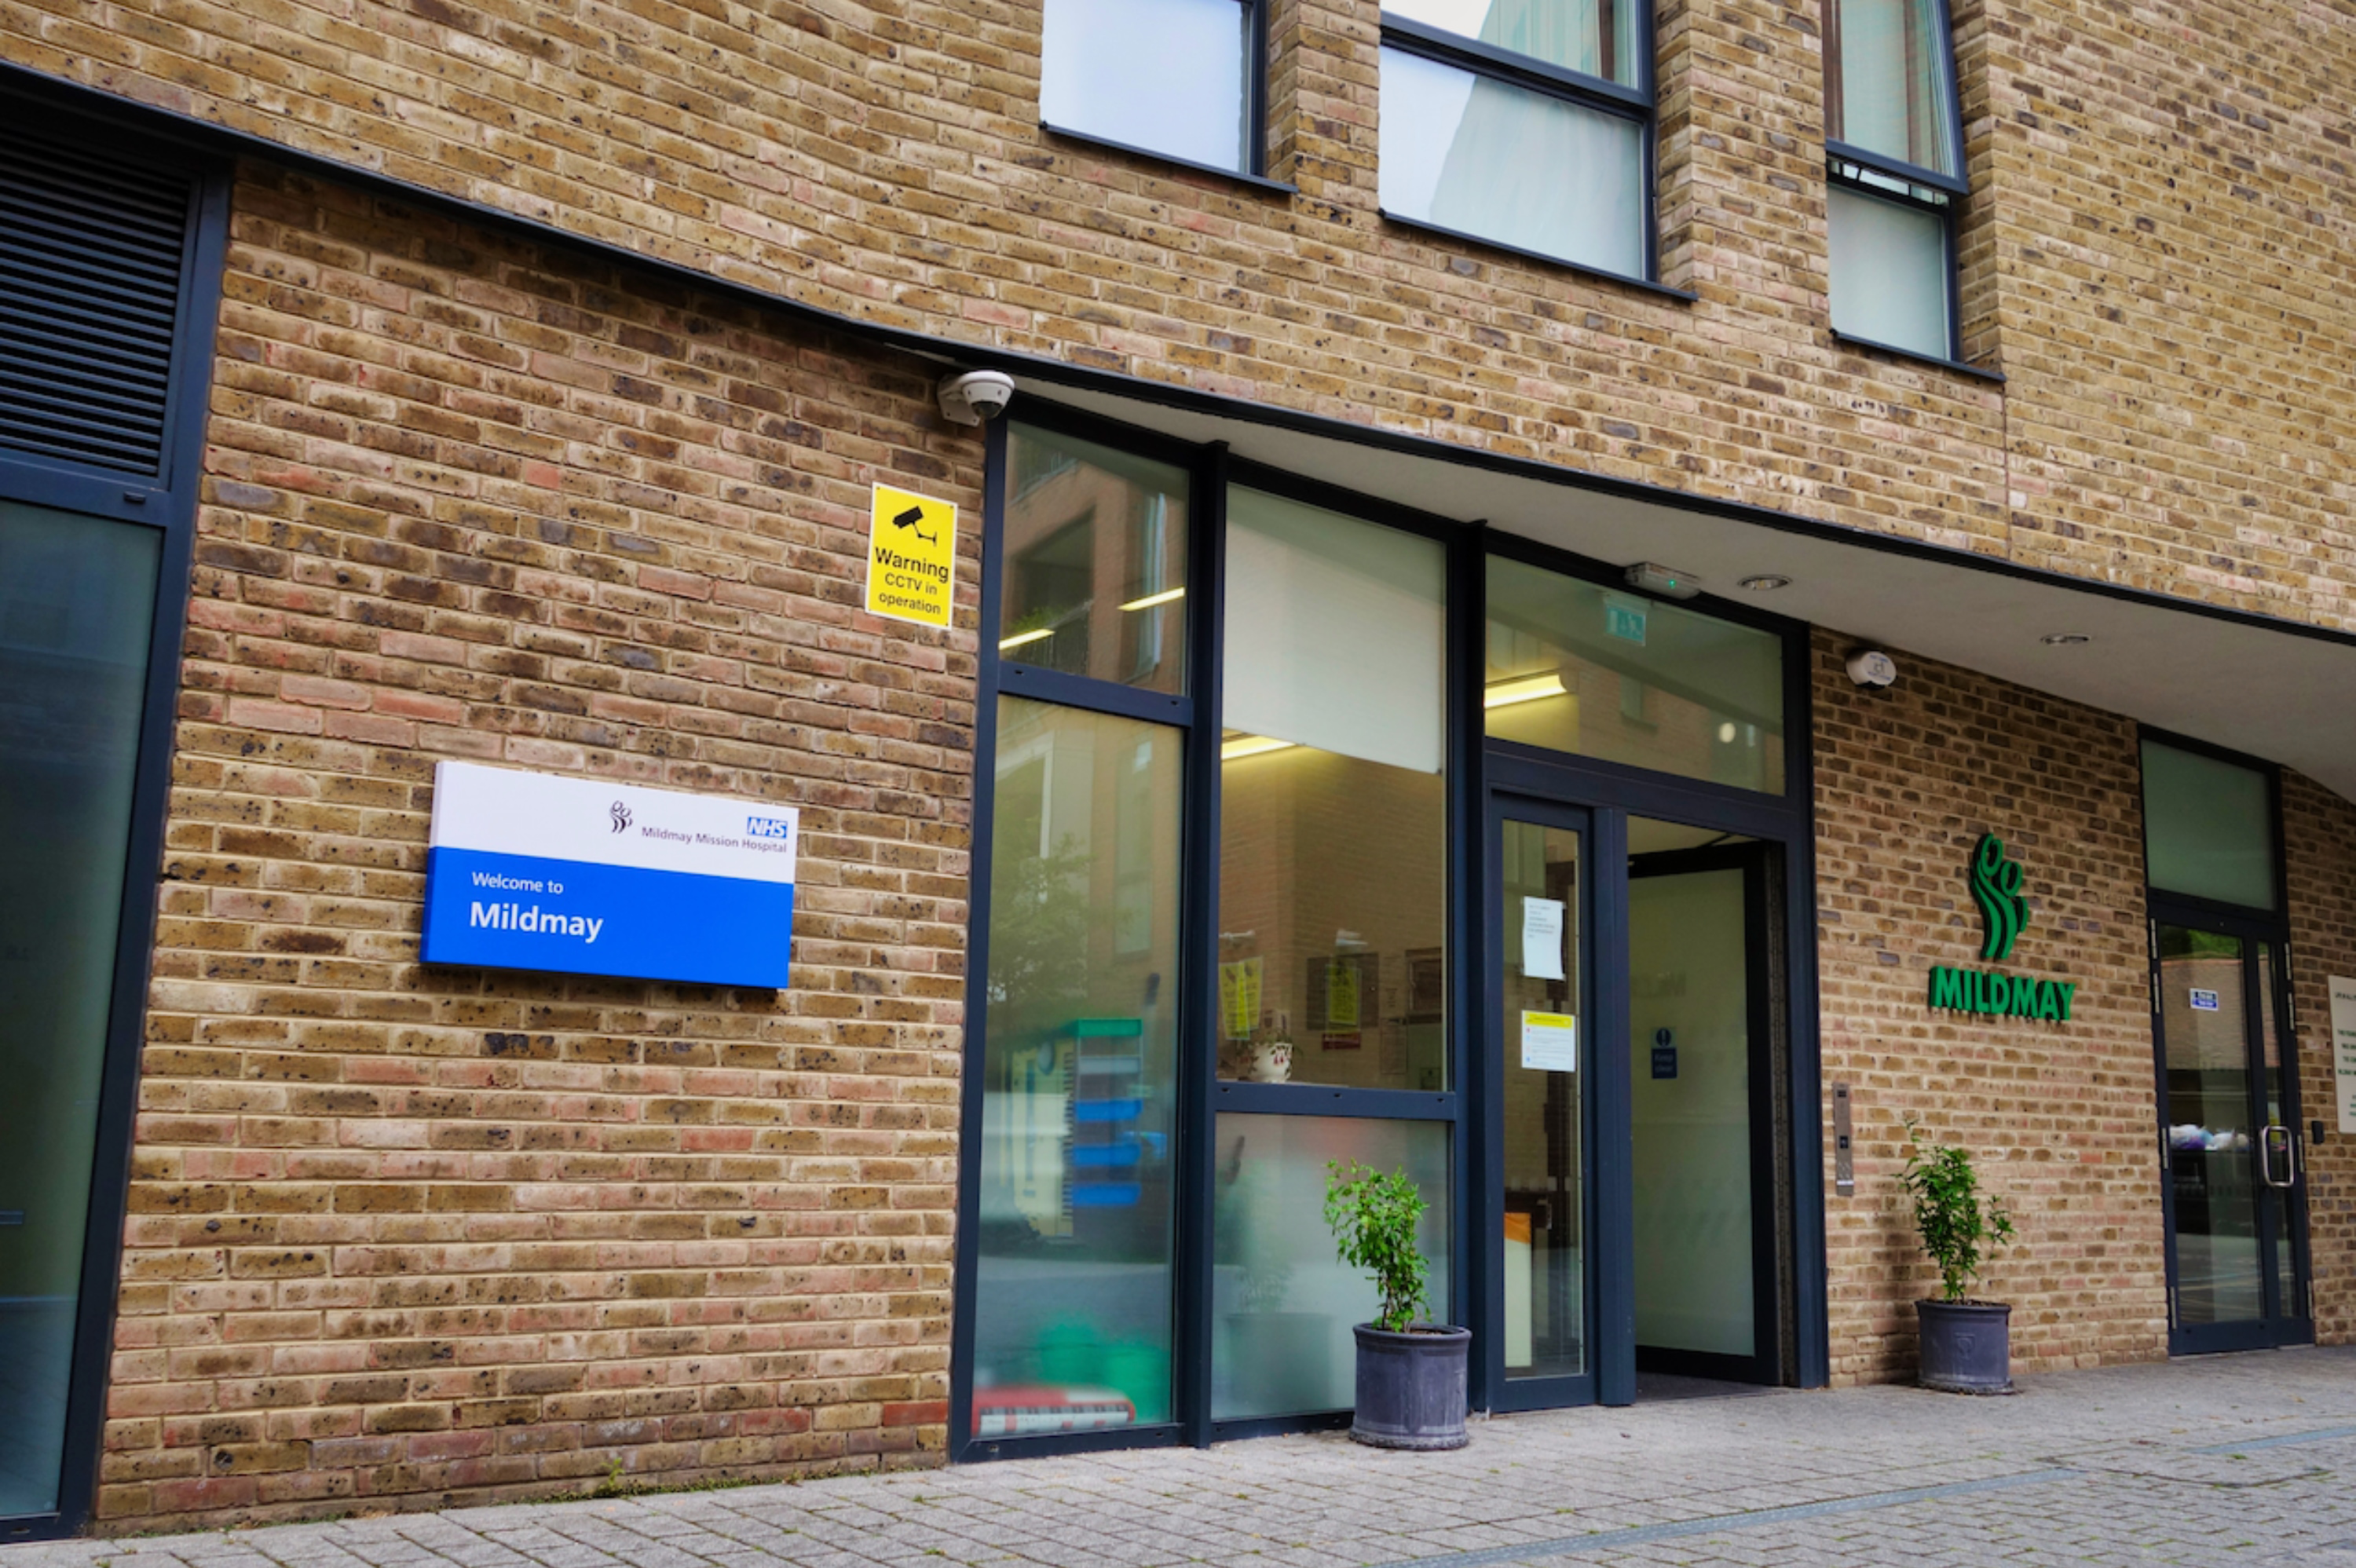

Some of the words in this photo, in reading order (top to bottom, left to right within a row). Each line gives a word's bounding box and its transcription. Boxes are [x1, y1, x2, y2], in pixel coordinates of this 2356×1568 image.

[875, 546, 948, 583] Warning
[884, 572, 923, 591] CCTV
[925, 581, 937, 594] in
[879, 593, 941, 614] operation
[642, 826, 693, 845] Mildmay
[695, 833, 738, 847] Mission
[741, 839, 786, 853] Hospital
[748, 817, 787, 838] NHS
[472, 871, 543, 893] Welcome
[547, 879, 564, 894] to
[470, 901, 603, 943] Mildmay
[1929, 966, 2076, 1021] MILDMAY
